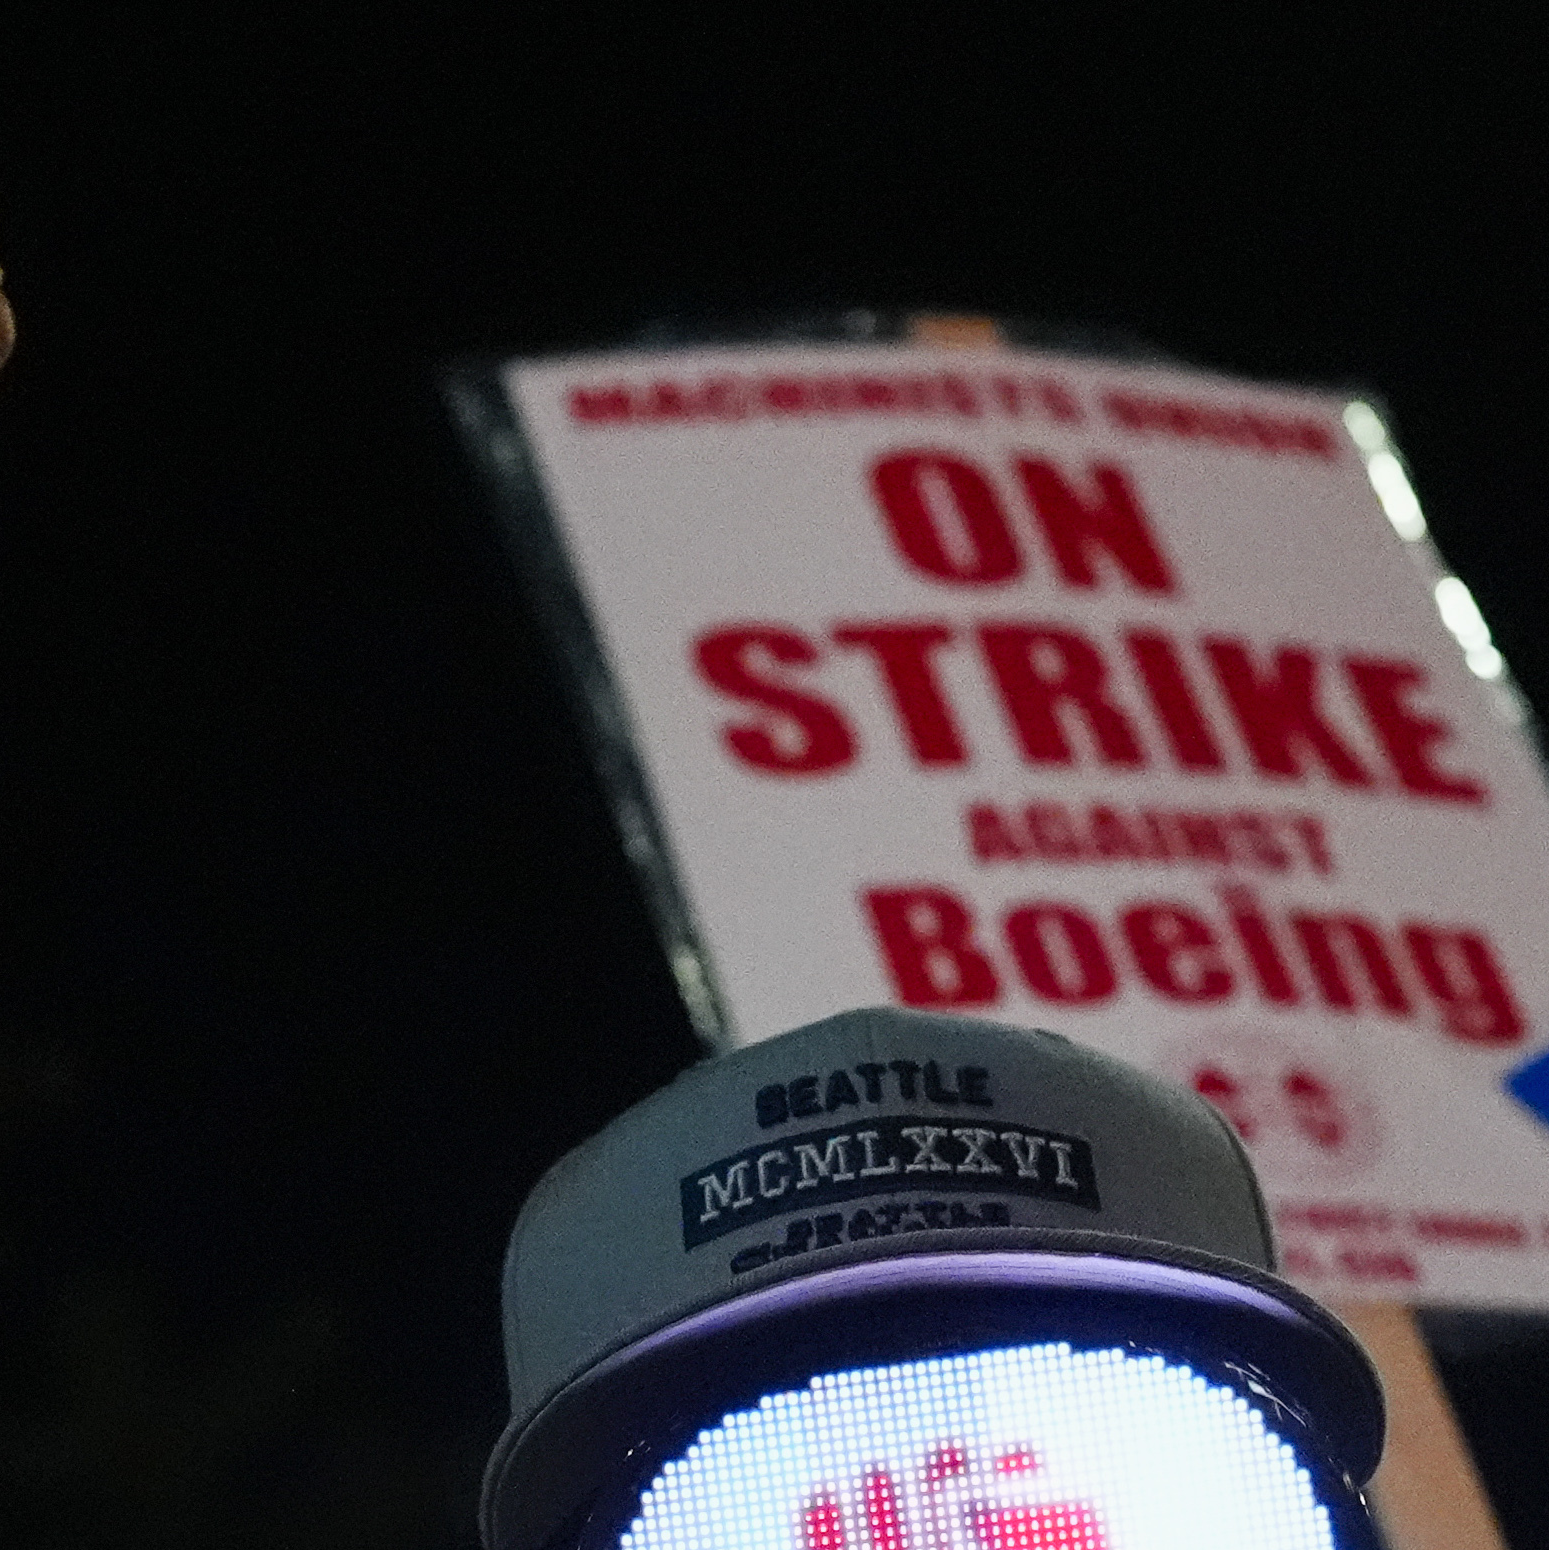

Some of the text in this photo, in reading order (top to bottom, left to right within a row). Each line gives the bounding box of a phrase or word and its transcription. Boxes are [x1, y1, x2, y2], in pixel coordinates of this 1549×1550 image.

[864, 444, 1184, 600] ON
[690, 620, 1494, 808] STRIKE
[962, 800, 1337, 880] AGAINST
[858, 878, 1532, 1050] Boeing
[754, 1058, 993, 1129] SEATTLE
[698, 1126, 1079, 1223] MCMLXXVI
